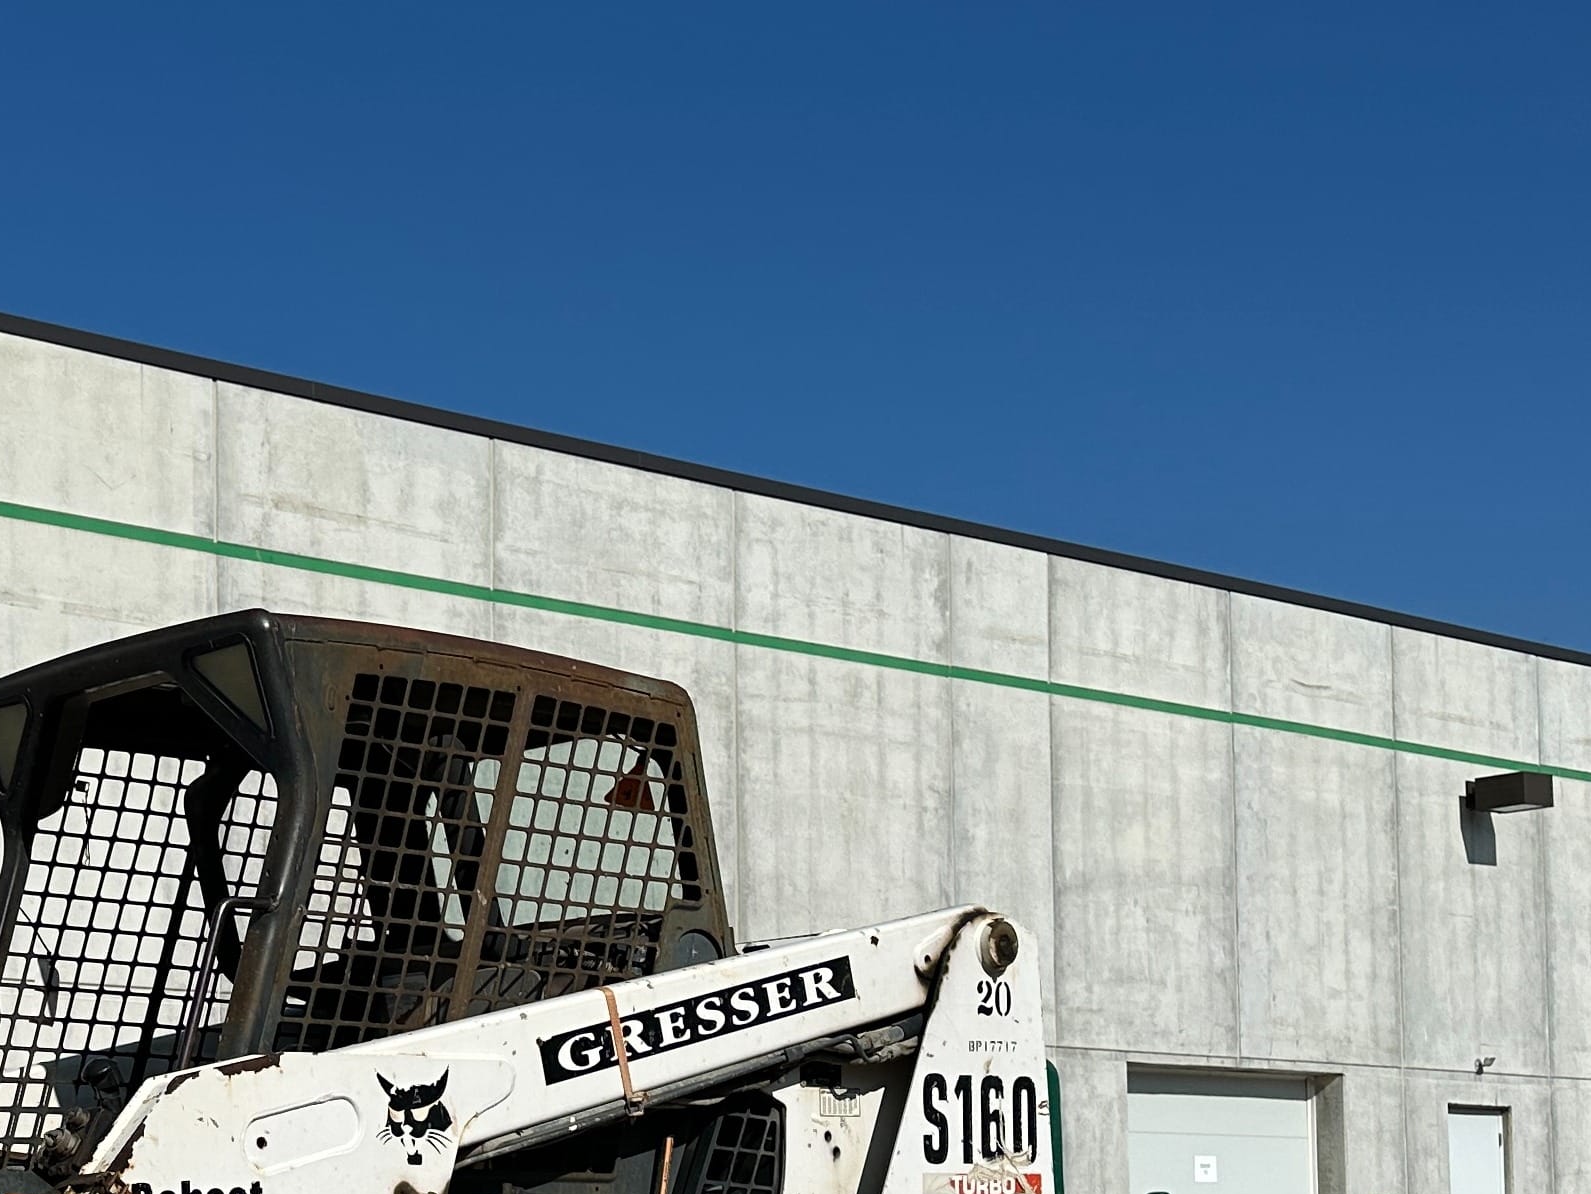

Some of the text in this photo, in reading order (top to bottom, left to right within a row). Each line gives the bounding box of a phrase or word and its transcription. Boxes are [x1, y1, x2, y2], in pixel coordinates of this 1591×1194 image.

[557, 966, 842, 1072] GRESSER
[976, 980, 1012, 1017] 20
[922, 1072, 1038, 1165] S160
